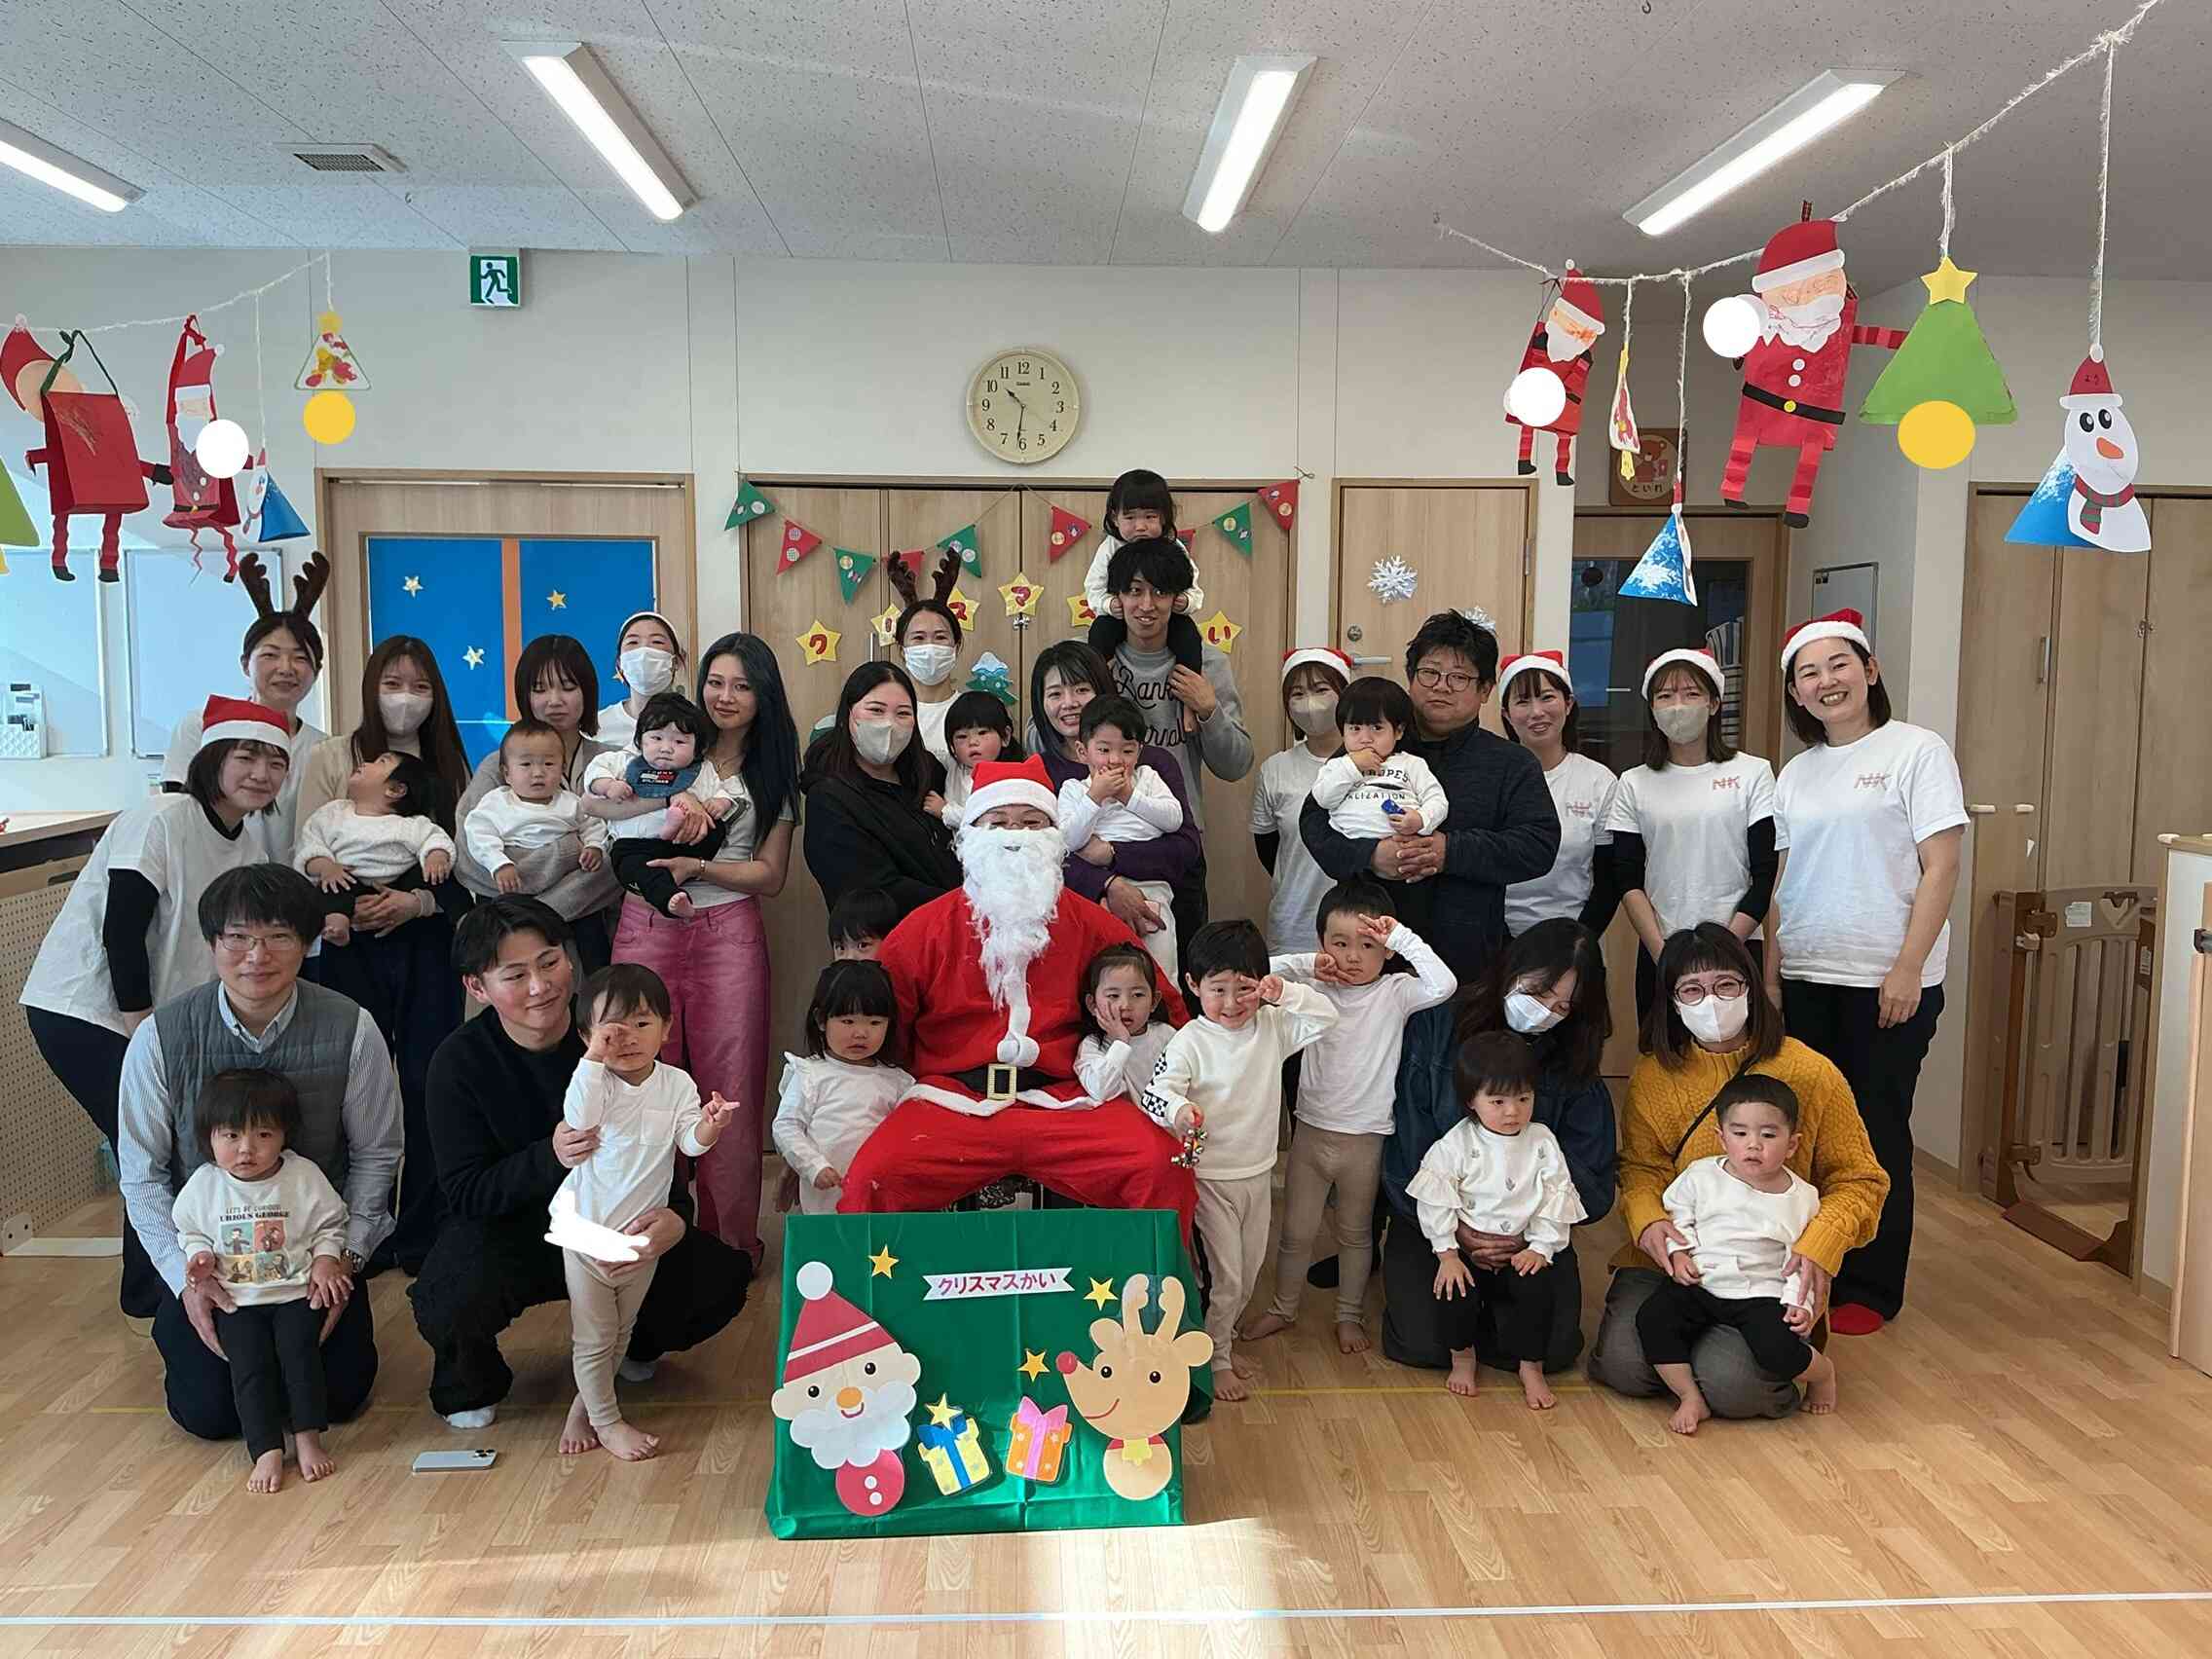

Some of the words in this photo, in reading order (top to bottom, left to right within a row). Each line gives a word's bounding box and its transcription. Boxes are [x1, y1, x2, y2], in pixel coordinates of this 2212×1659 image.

[1001, 366, 1009, 380] 11
[1017, 361, 1030, 375] 12
[1040, 367, 1045, 380] 1
[987, 380, 998, 393] 10
[1051, 381, 1060, 394] 2
[981, 398, 990, 411] 9
[1055, 400, 1064, 414] 3
[986, 418, 995, 430] 8
[1050, 419, 1057, 431] 4
[1001, 432, 1008, 445] 7
[1018, 437, 1027, 451] 6
[1037, 433, 1046, 446] 5
[1632, 484, 1663, 493] といれ
[1207, 625, 1231, 645] い
[938, 1272, 1057, 1296] クリスマスかい
